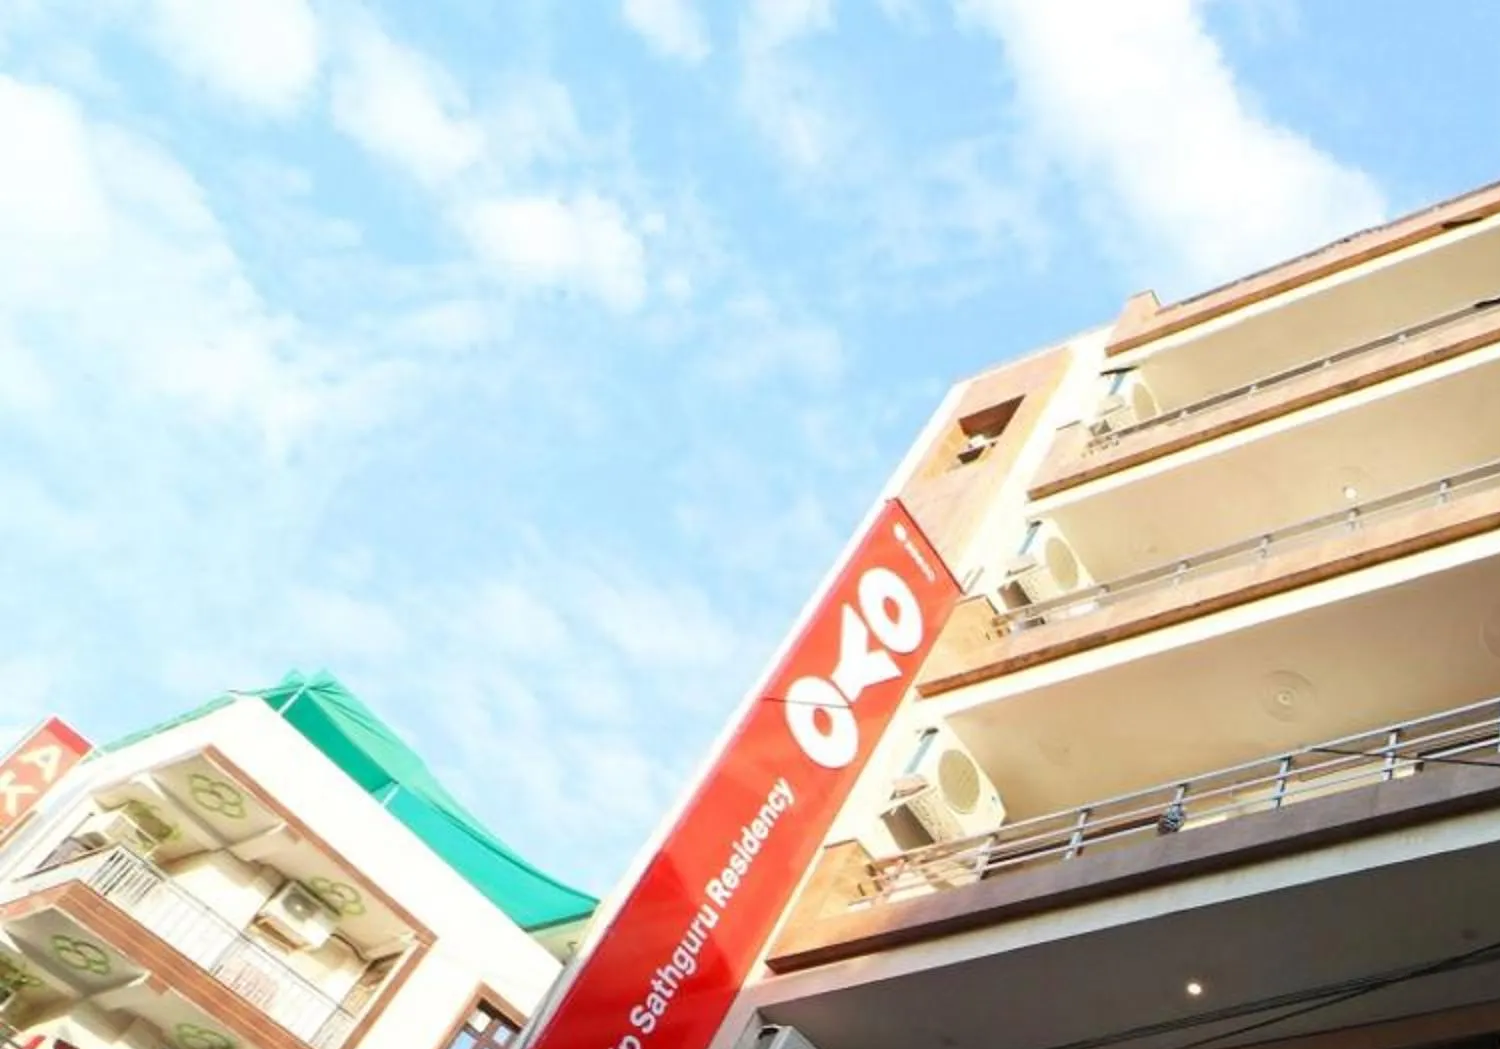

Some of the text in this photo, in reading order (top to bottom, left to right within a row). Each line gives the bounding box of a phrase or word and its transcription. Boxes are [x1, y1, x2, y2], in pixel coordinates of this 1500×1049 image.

[785, 566, 924, 769] OYO
[629, 904, 719, 1035] Sathguru
[705, 776, 796, 909] Residency
